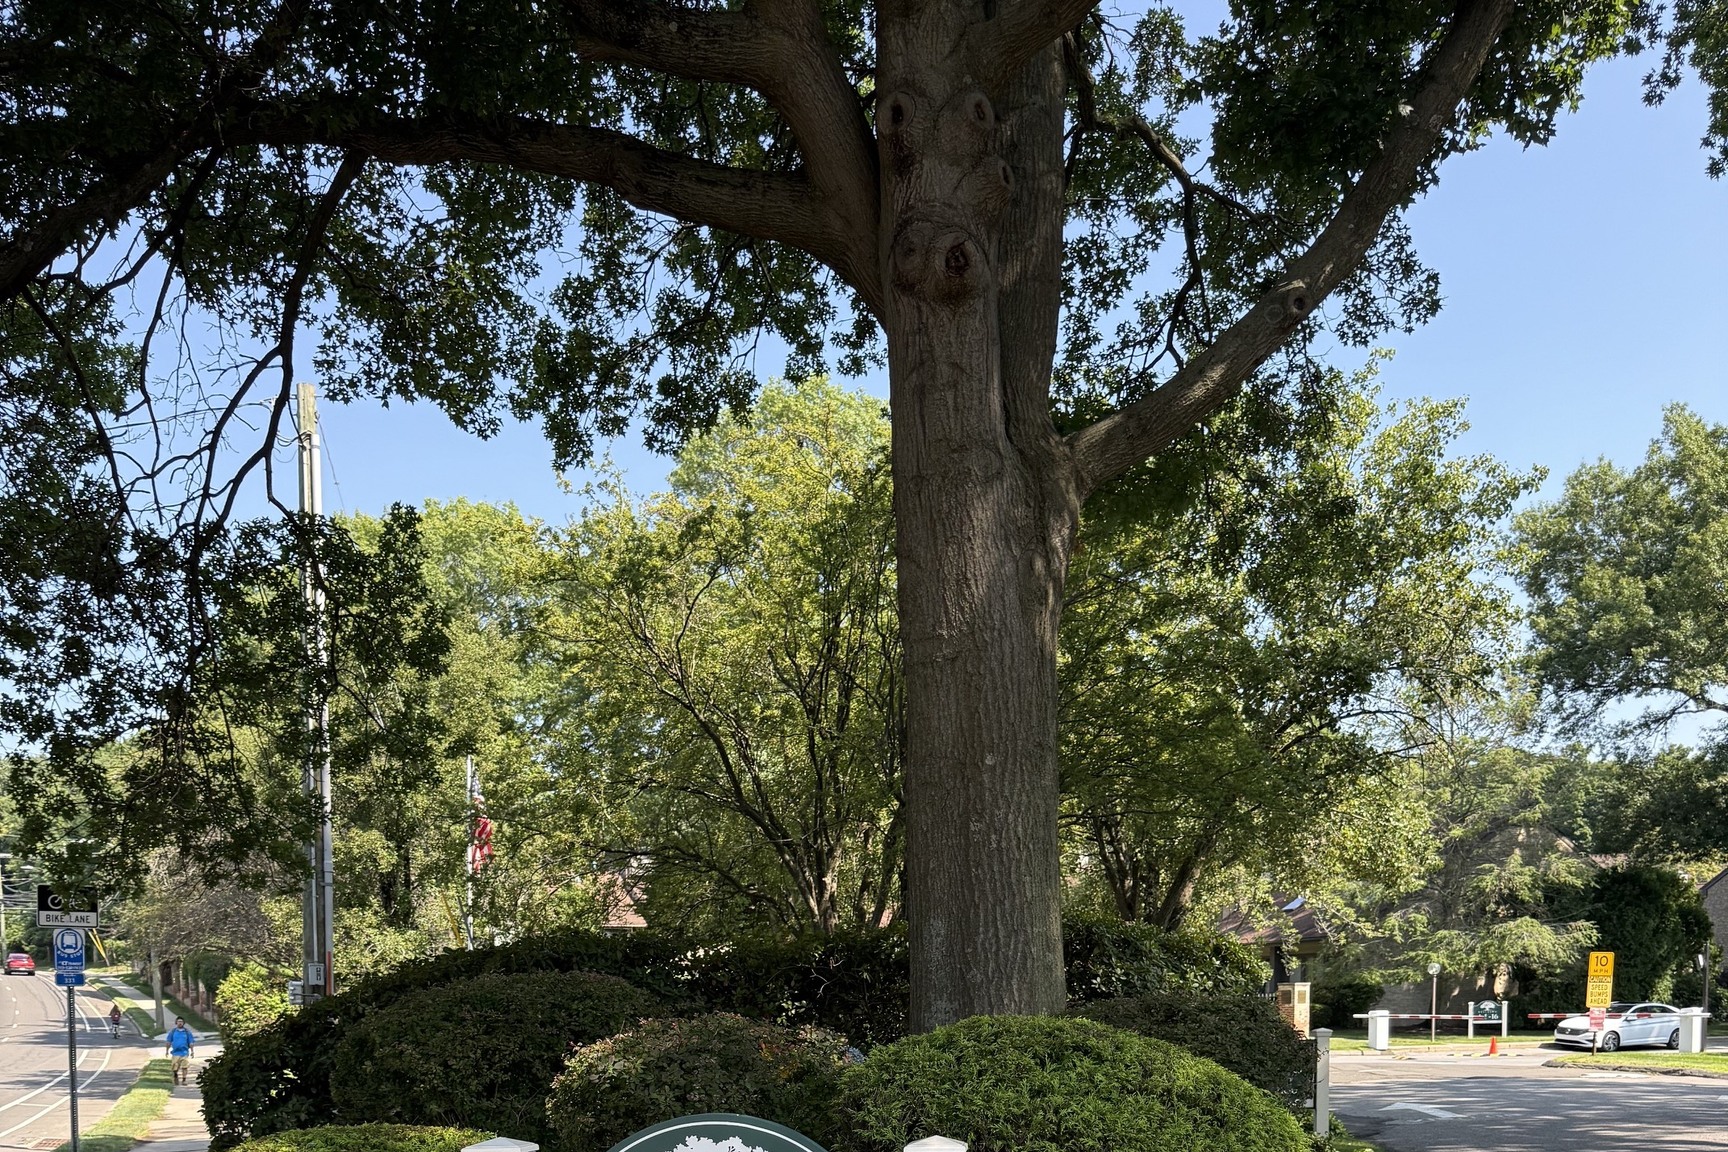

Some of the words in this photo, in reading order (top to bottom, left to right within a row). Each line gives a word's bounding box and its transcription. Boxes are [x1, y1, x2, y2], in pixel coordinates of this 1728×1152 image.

[45, 914, 65, 923] BIKE
[70, 915, 91, 924] LANE
[1595, 955, 1608, 967] 10
